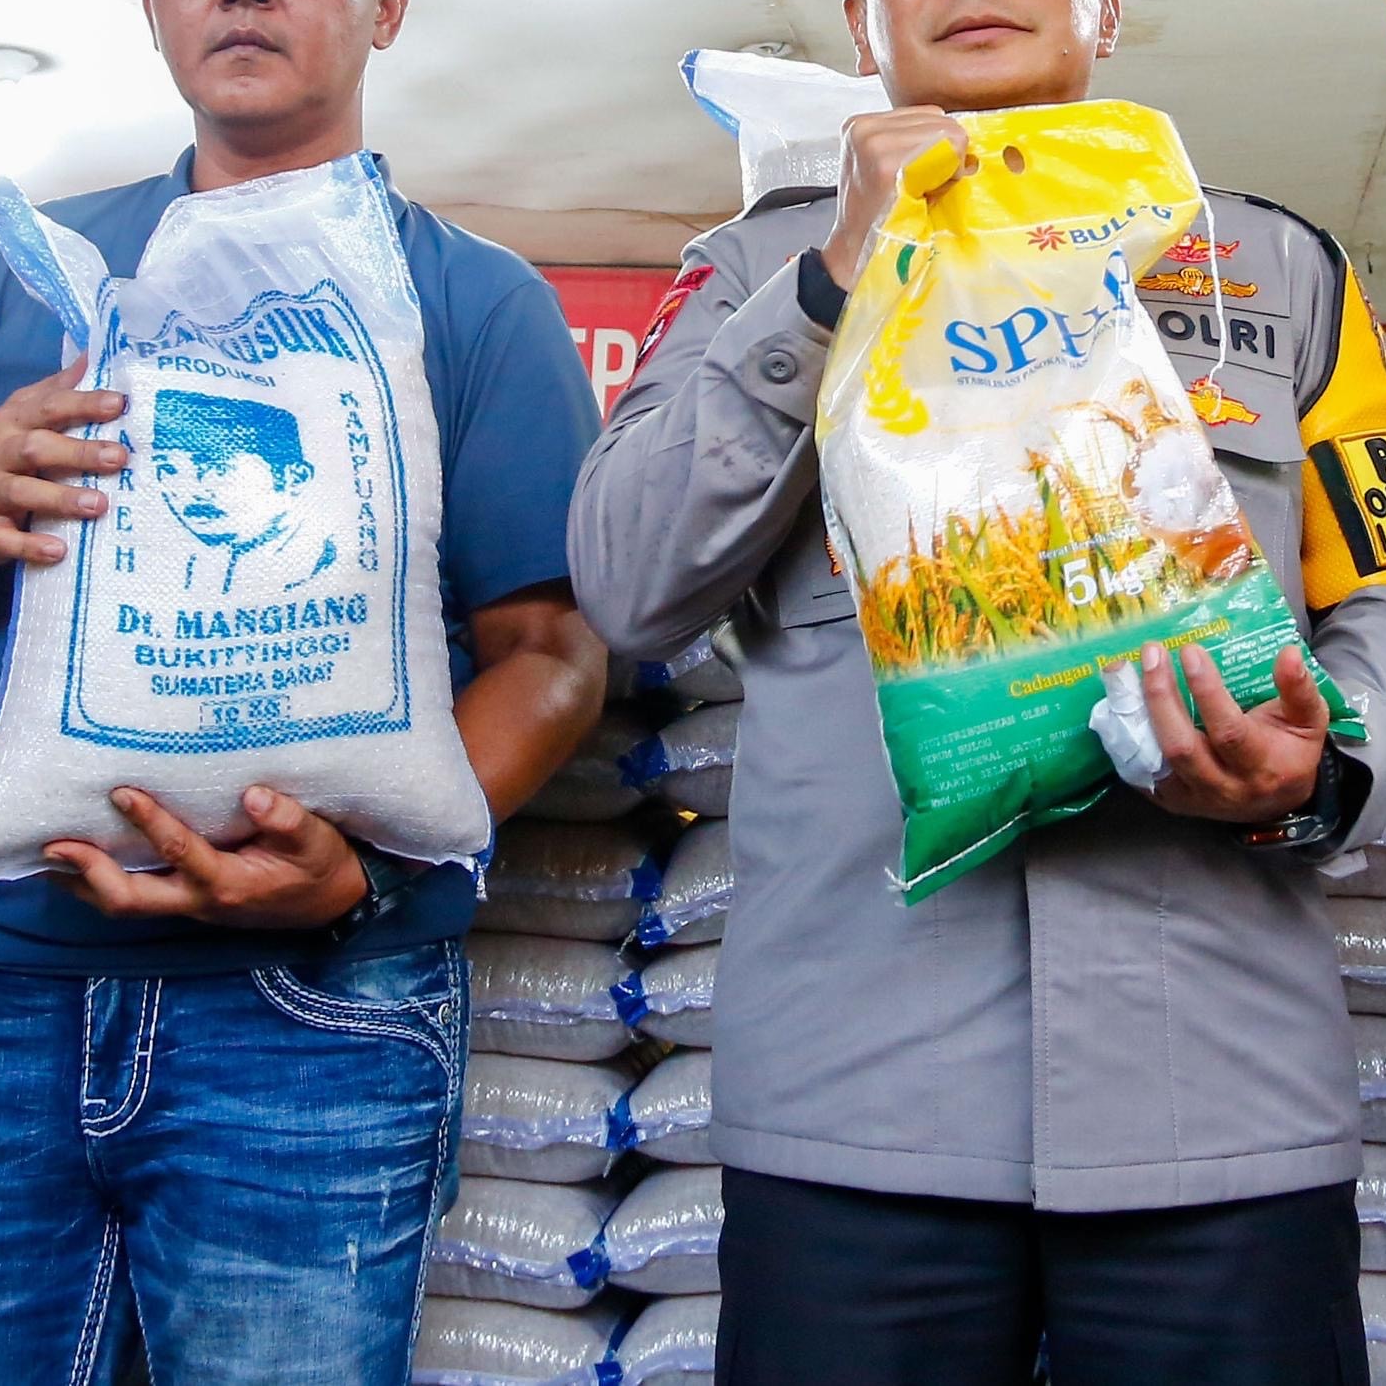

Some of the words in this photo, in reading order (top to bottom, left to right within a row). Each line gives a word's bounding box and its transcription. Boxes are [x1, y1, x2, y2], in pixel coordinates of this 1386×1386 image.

[1069, 204, 1173, 244] BULG
[1158, 310, 1276, 360] OLRI
[157, 355, 277, 387] PRODUKSI
[1062, 557, 1098, 606] 5
[175, 592, 368, 640] MANGIANG
[134, 631, 351, 669] BUKITTINGGI
[151, 670, 267, 697] SUMATERA
[272, 660, 336, 691] BARAT
[1009, 661, 1093, 699] Cadangan
